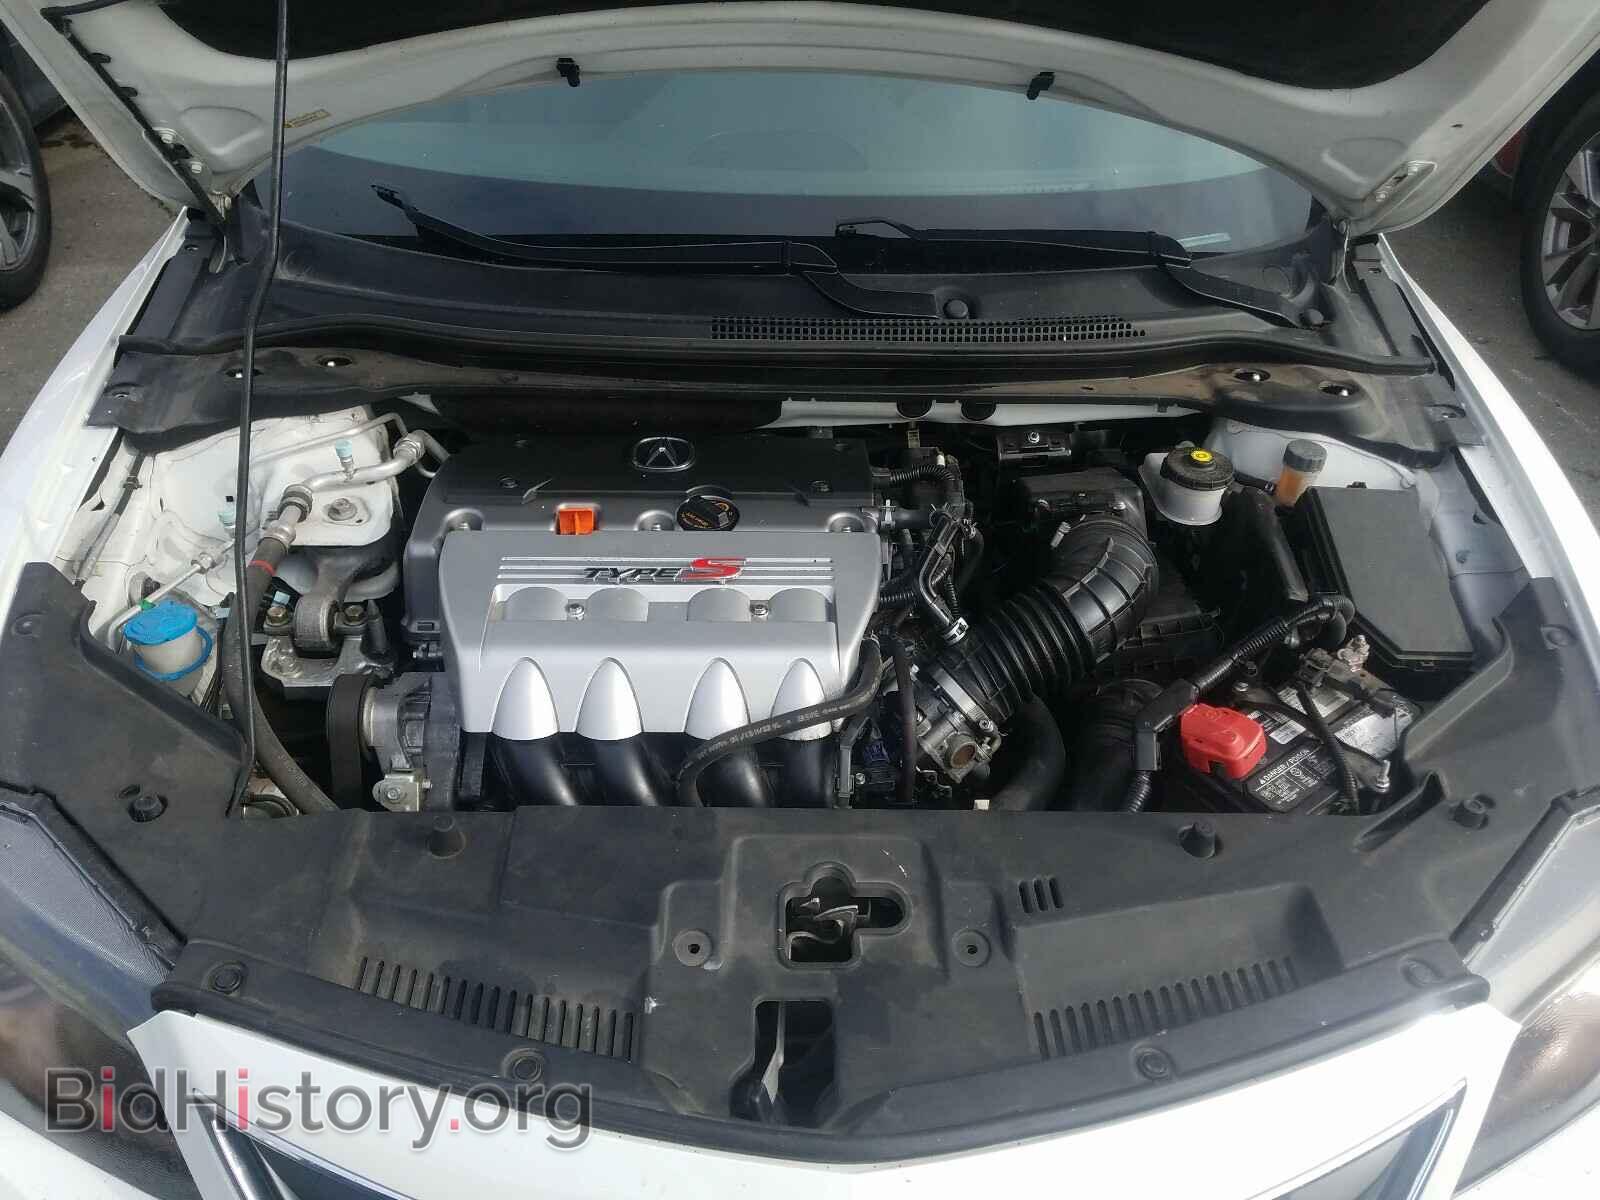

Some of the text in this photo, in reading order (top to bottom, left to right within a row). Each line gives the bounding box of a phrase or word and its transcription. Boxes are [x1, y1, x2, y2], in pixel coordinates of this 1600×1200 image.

[584, 557, 747, 584] TYPE S
[1263, 764, 1287, 780] DANGER
